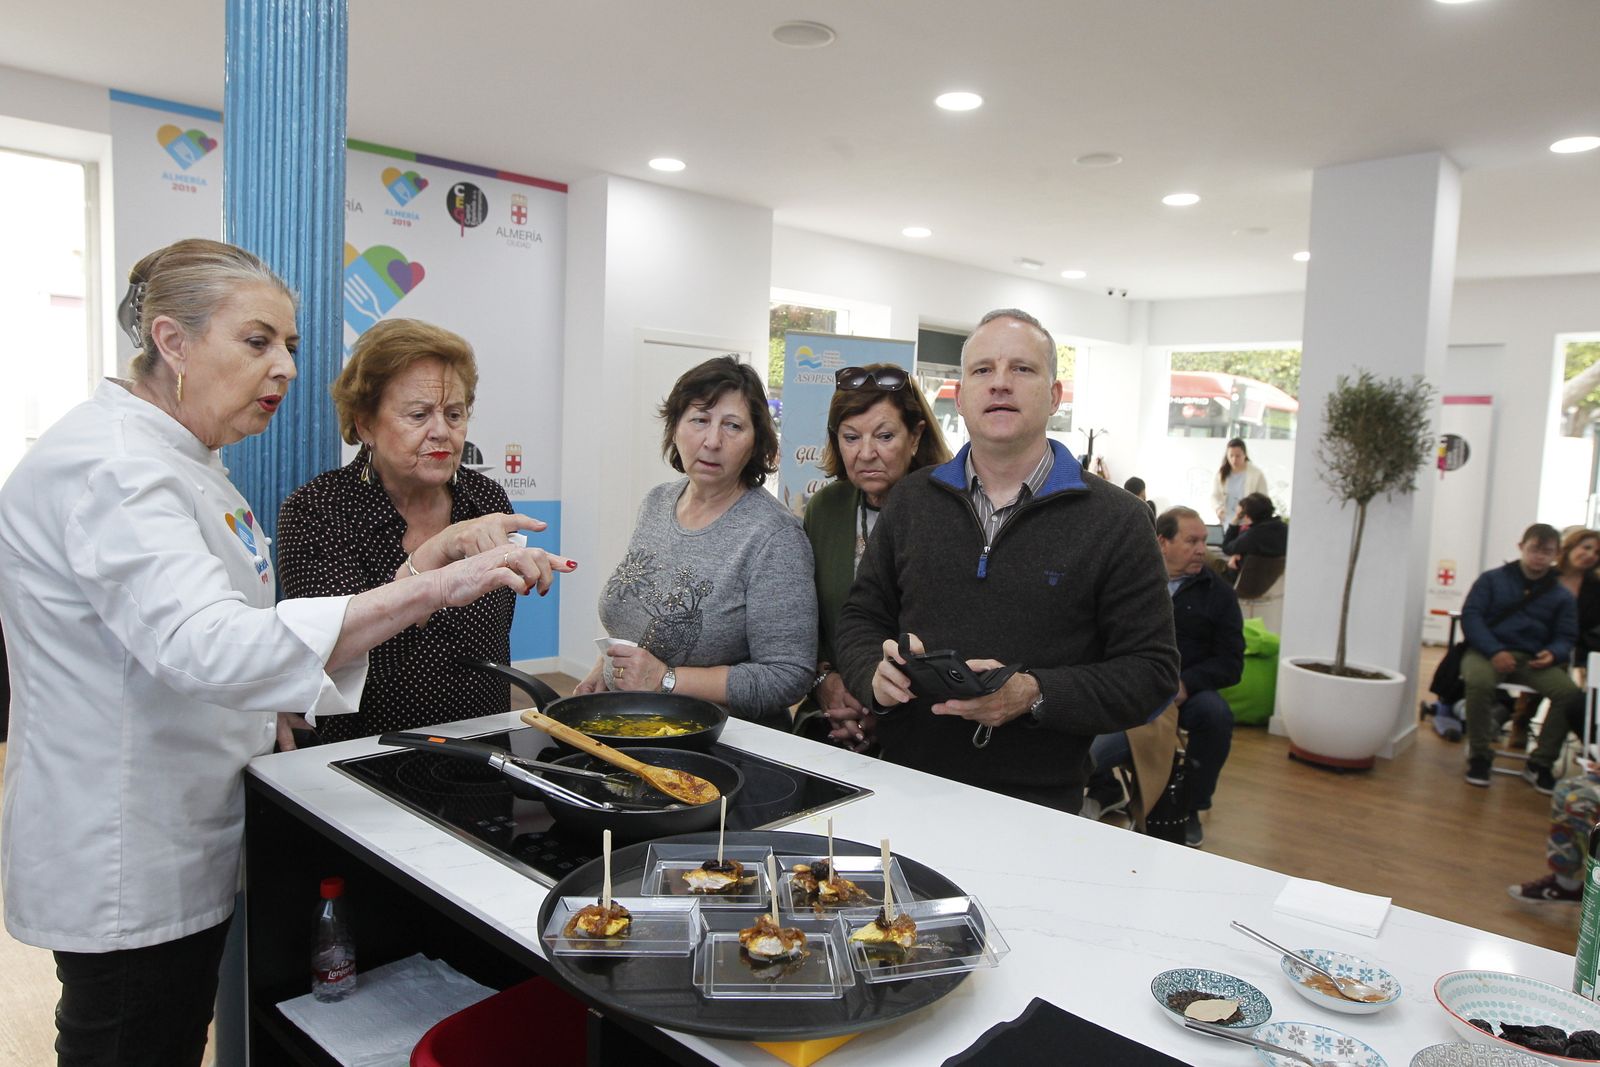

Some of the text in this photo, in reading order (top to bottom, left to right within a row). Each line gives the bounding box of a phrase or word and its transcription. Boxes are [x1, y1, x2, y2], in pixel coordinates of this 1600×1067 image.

[345, 198, 364, 214] RÍA
[384, 208, 421, 221] ALMERÍA
[392, 218, 412, 228] 2019
[496, 226, 543, 243] ALMERÍA
[506, 238, 532, 249] CIUDAD
